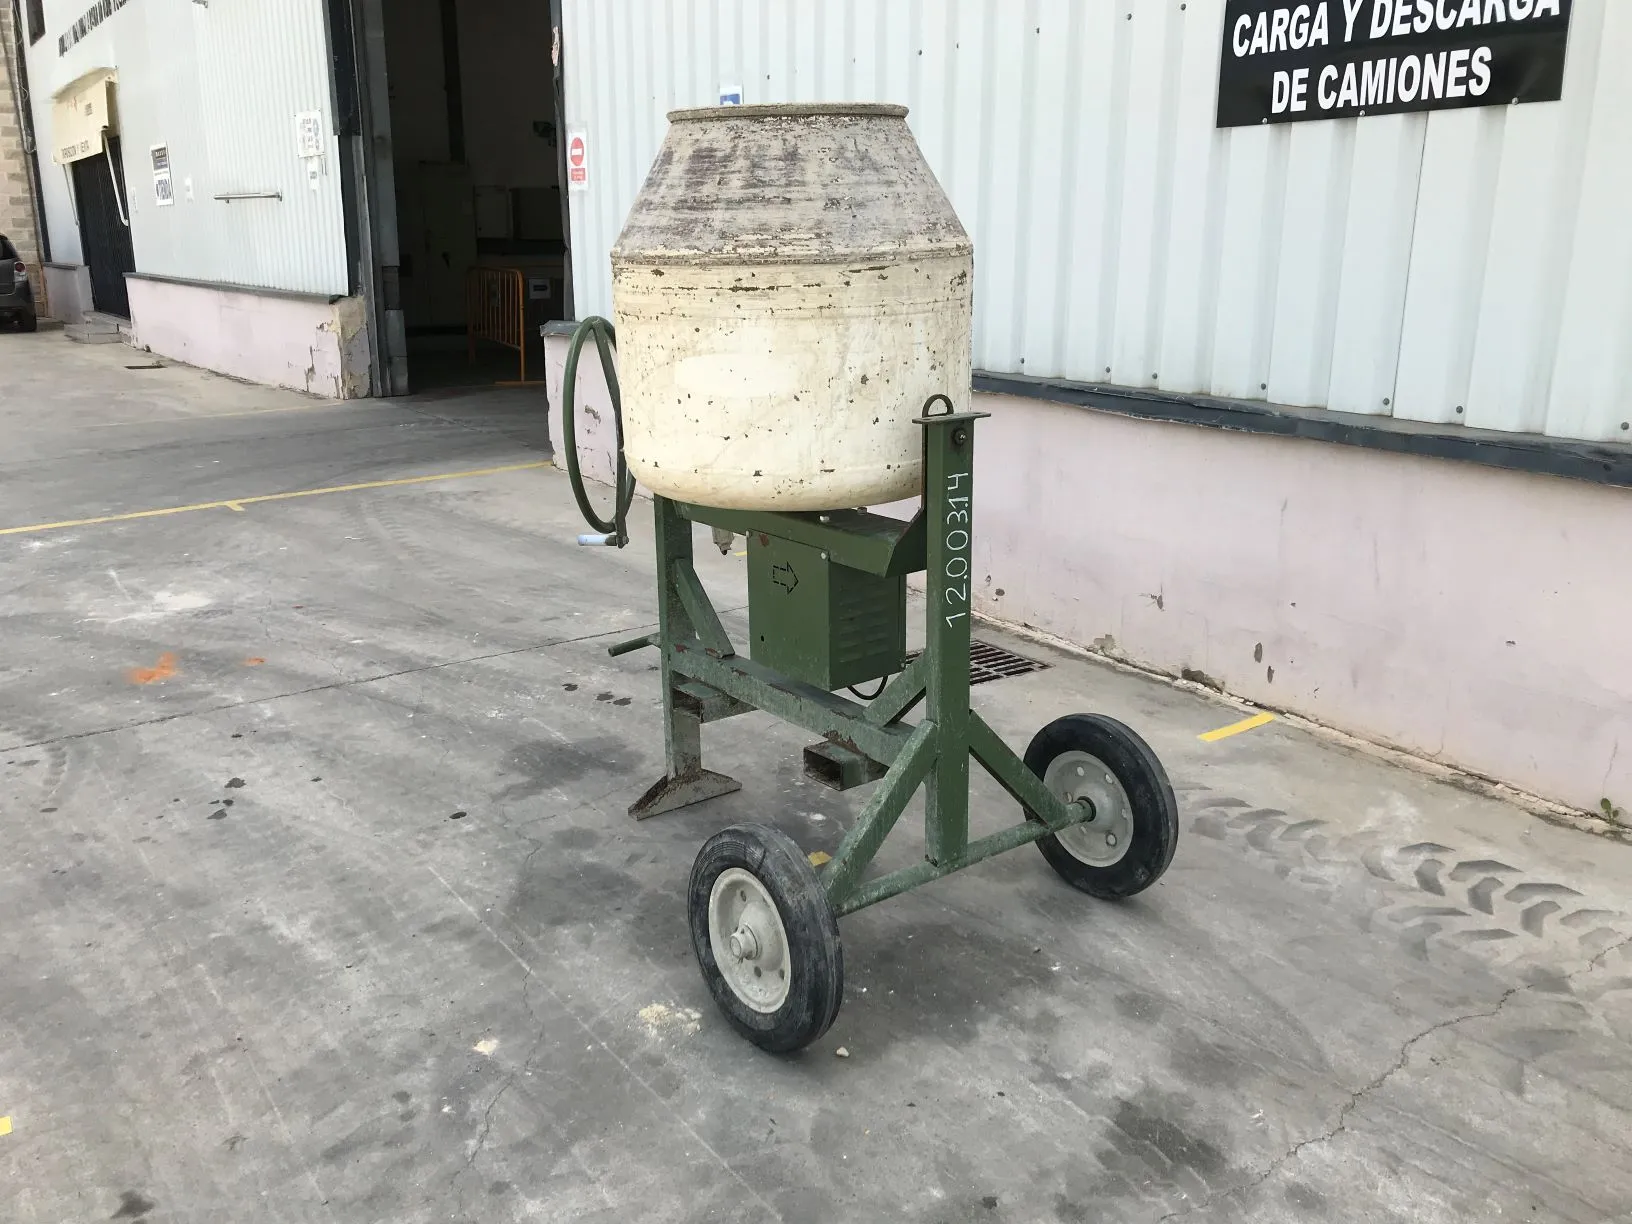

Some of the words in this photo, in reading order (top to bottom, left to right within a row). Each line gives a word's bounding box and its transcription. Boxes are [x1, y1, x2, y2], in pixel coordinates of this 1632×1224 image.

[1233, 2, 1329, 57] CARGA
[1342, 0, 1363, 42] Y
[1272, 68, 1309, 113] DE
[1318, 46, 1492, 110] CAMIONES
